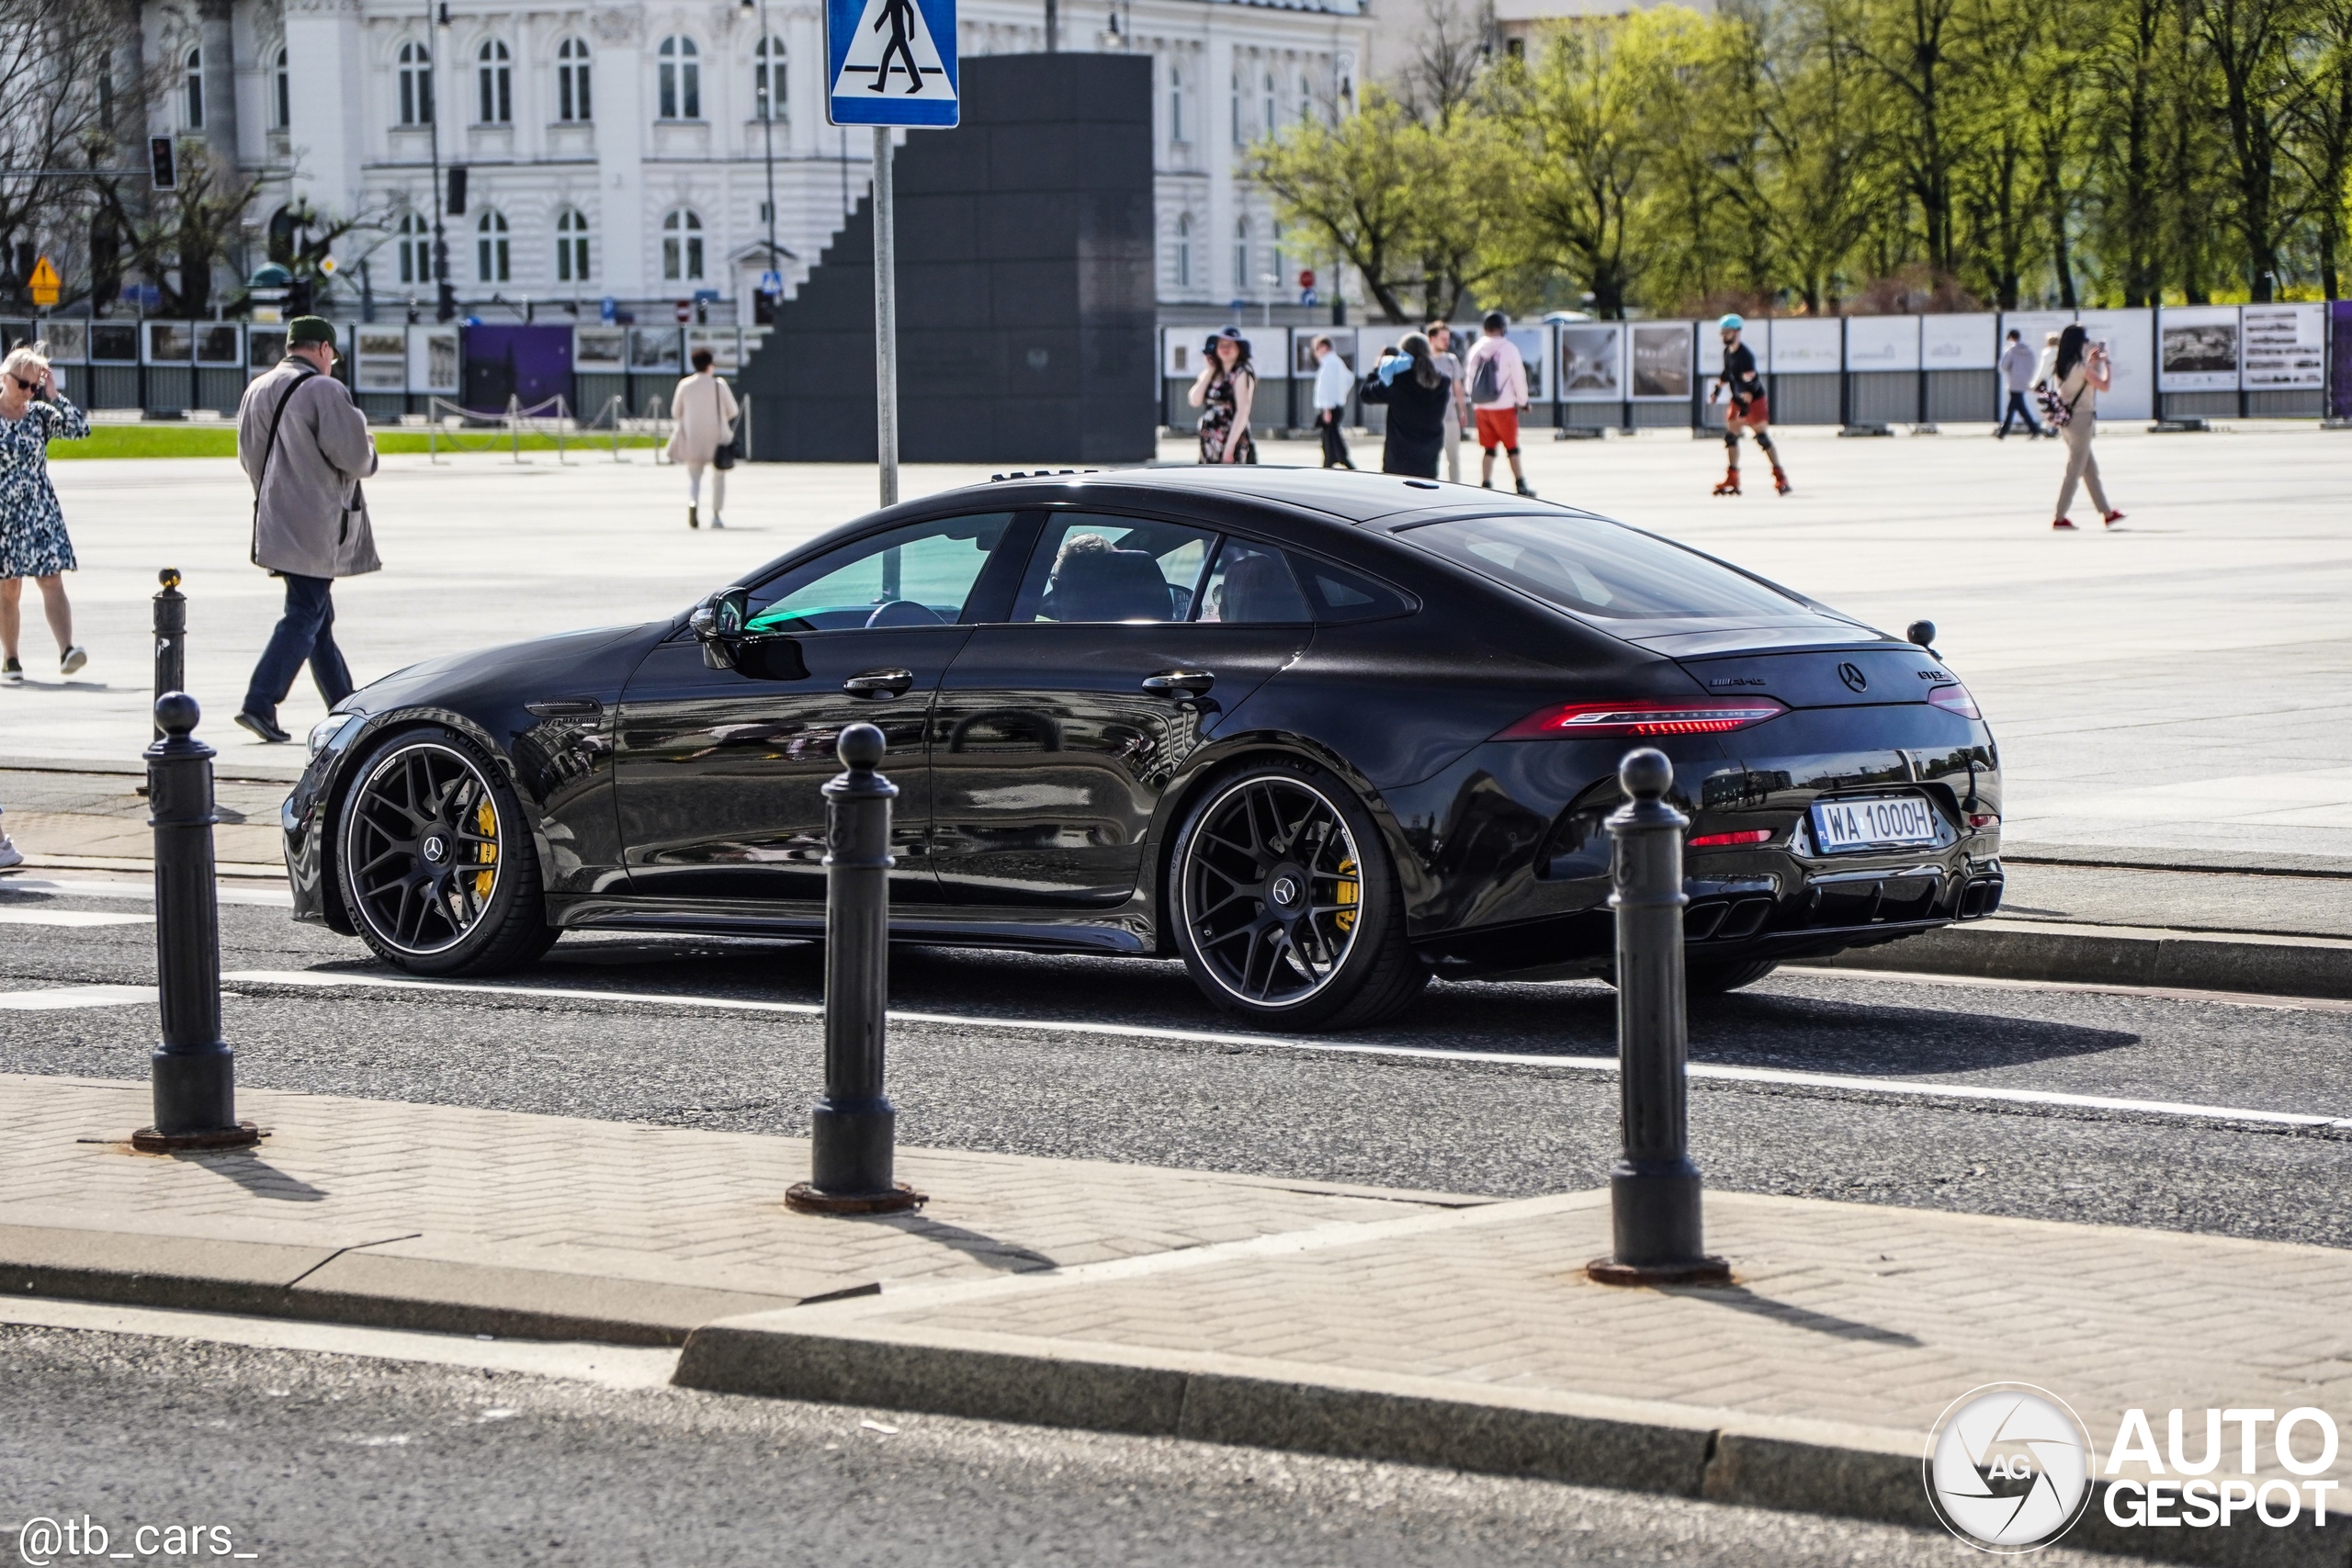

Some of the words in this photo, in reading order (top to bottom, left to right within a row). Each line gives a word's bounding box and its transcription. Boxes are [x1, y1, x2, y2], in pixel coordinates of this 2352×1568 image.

[456, 734, 503, 789] MICHELIN
[1818, 830, 1827, 840] PL
[1827, 807, 1861, 841] WA
[1866, 802, 1929, 838] 1000H
[348, 908, 394, 962] MICHELIN
